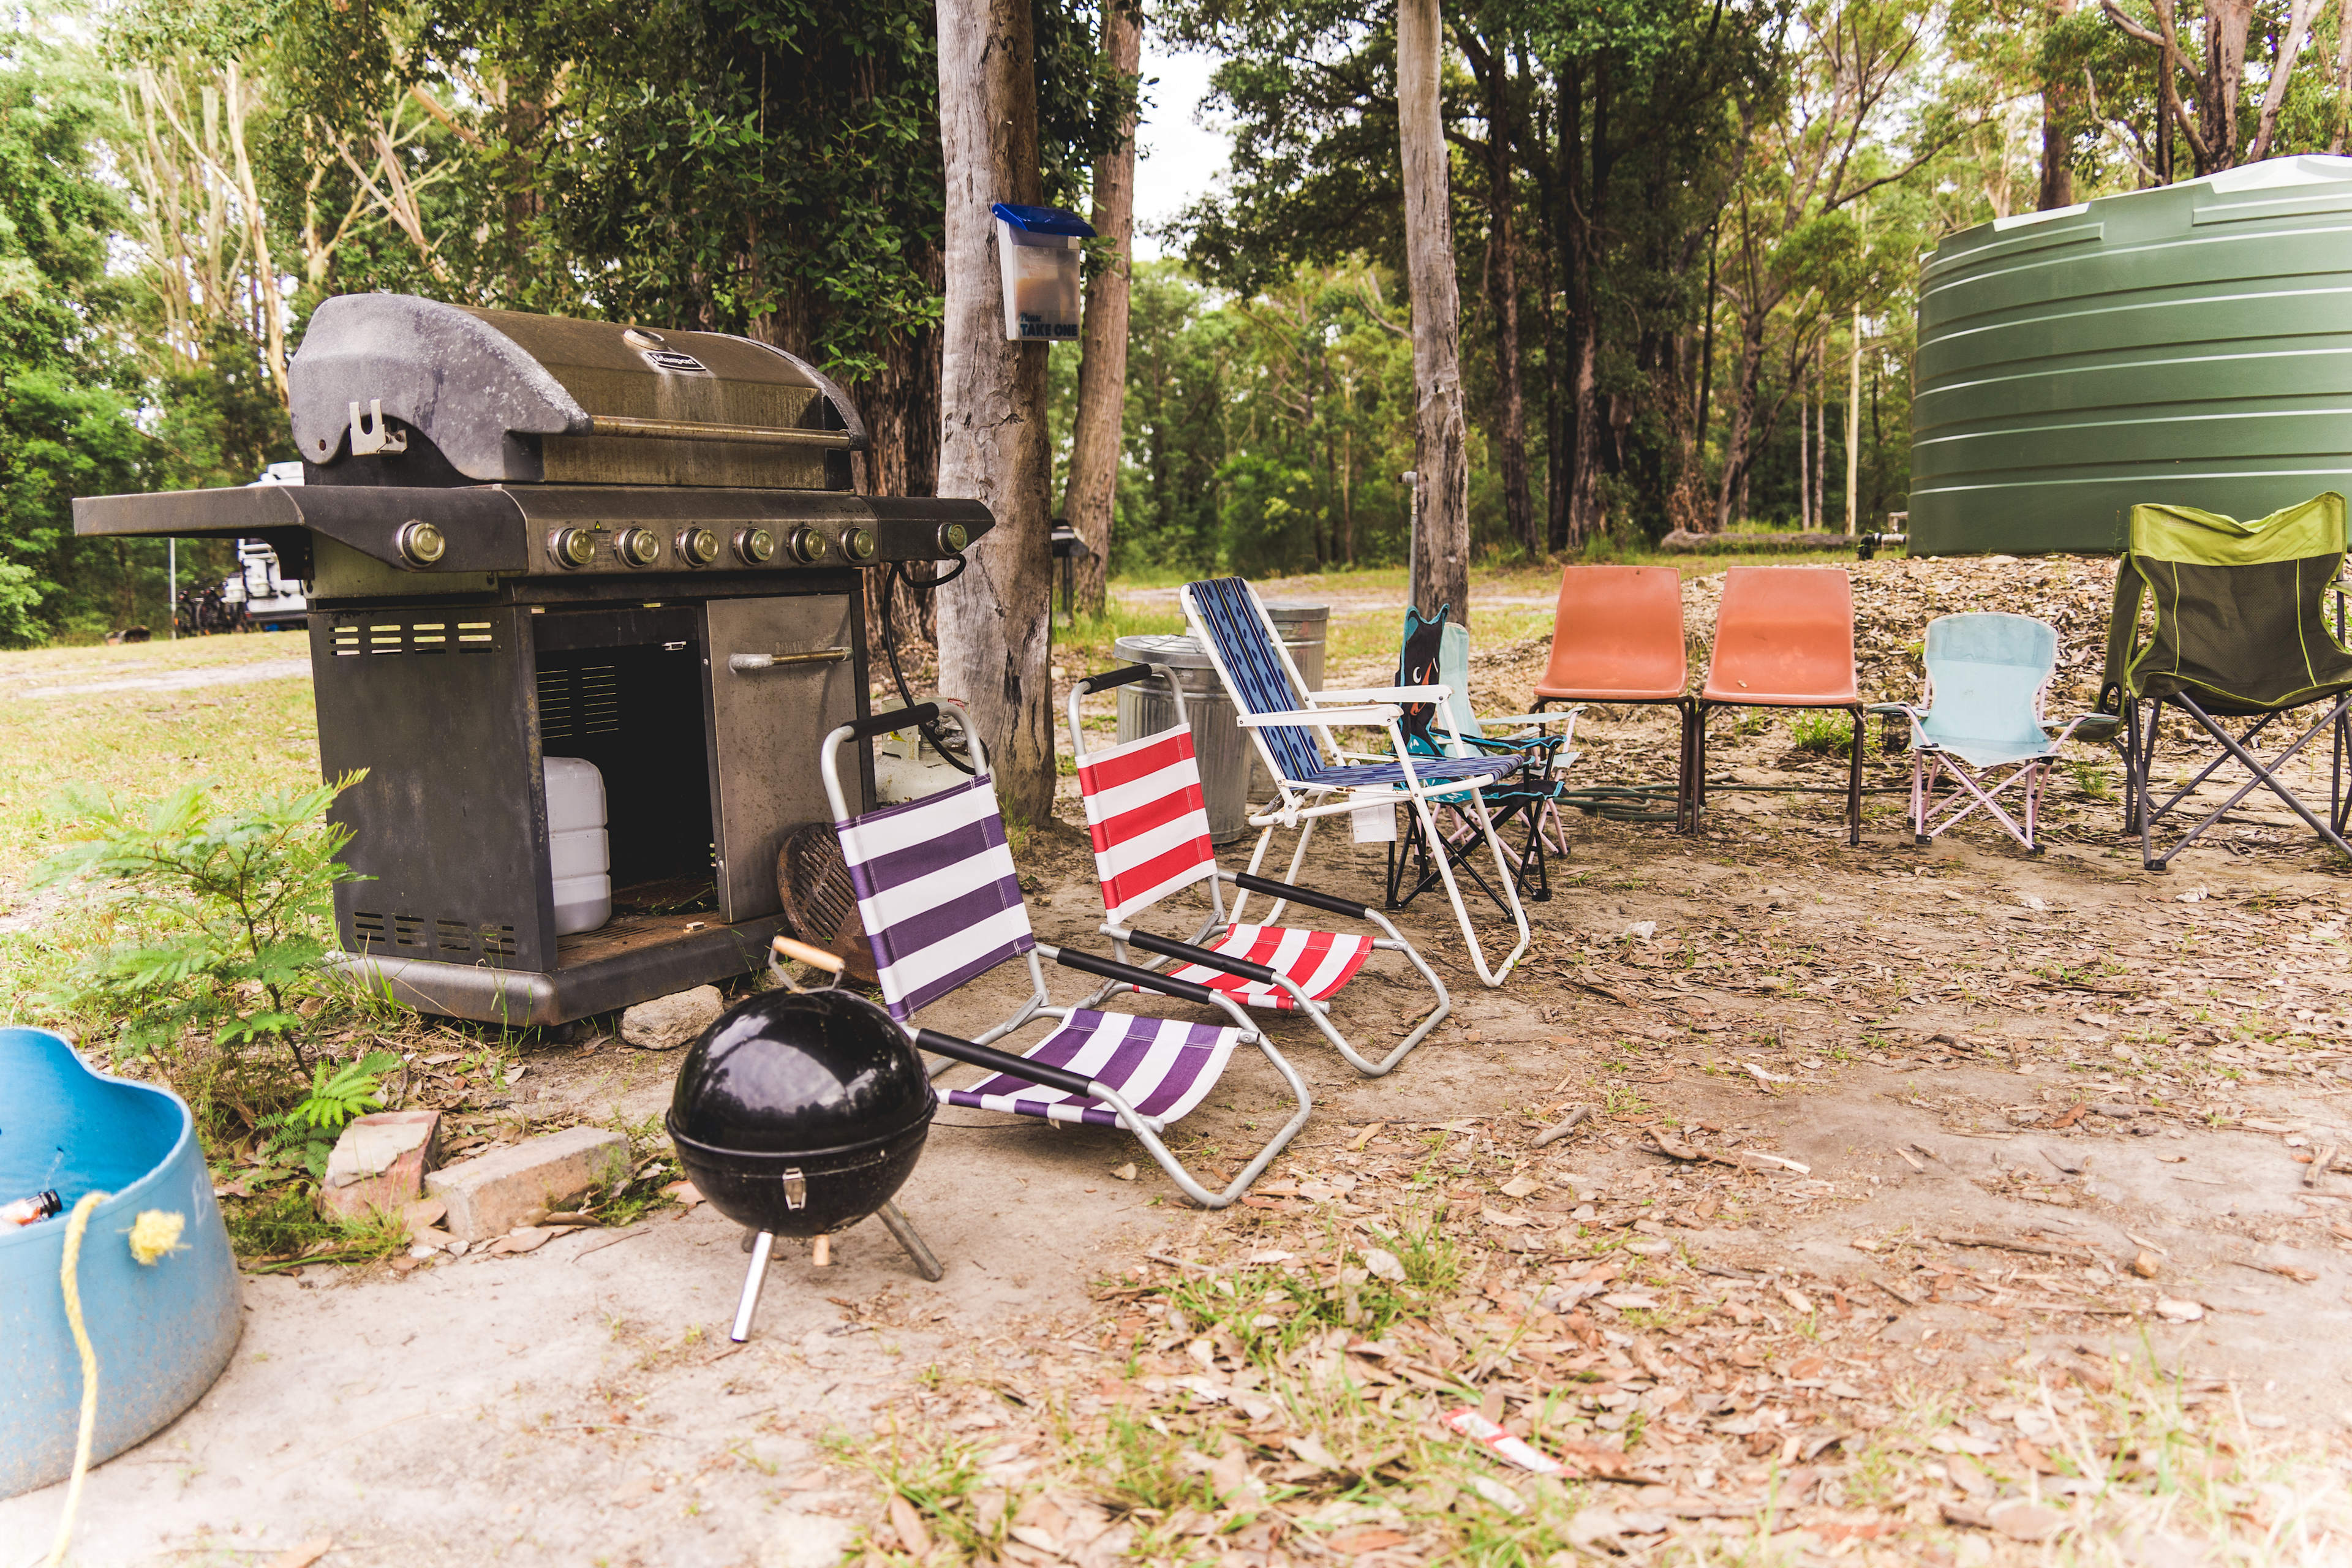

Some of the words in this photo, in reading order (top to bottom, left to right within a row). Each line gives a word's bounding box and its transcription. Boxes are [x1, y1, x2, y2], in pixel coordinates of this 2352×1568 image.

[1020, 323, 1052, 336] TAKE
[1054, 323, 1077, 336] ONE
[652, 355, 696, 365] Masport
